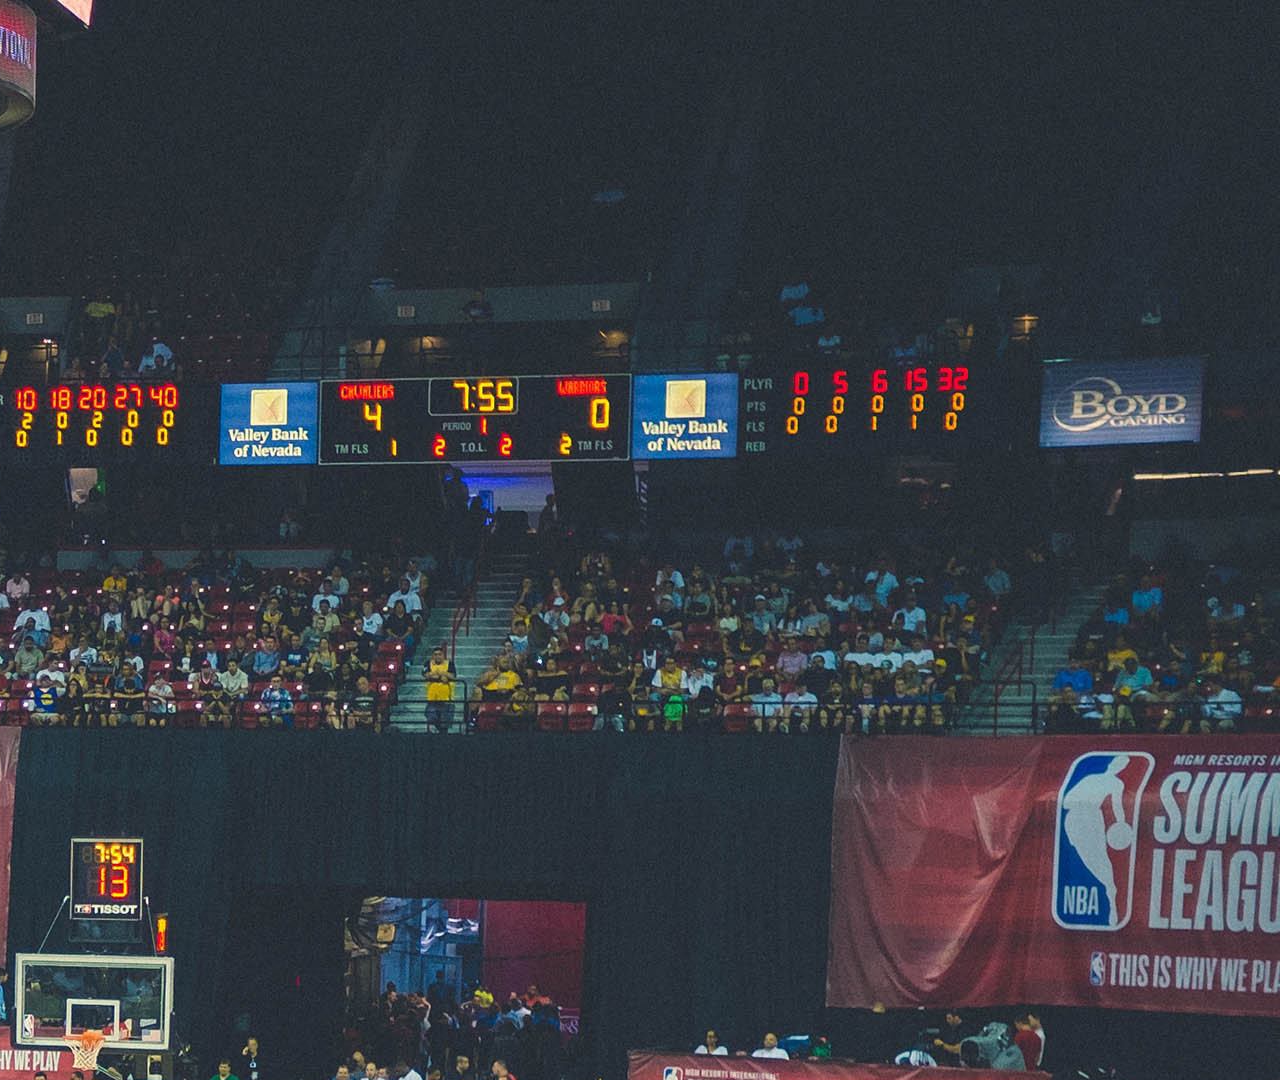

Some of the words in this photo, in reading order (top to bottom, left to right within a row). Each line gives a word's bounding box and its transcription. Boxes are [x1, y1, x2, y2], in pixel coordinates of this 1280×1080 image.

[744, 378, 773, 390] PLYR
[794, 372, 809, 396] 0
[834, 371, 848, 395] 5
[872, 370, 887, 394] 6
[906, 369, 928, 391] 15
[939, 367, 969, 391] 32
[16, 389, 37, 410] 10
[51, 388, 72, 409] 18
[80, 388, 106, 409] 20
[115, 386, 142, 408] 27
[149, 386, 177, 407] 40
[453, 379, 514, 412] 7:55
[747, 401, 766, 412] PTS
[793, 397, 805, 415] 0
[833, 396, 844, 415] 0
[872, 395, 884, 413] 0
[912, 394, 924, 412] 0
[952, 393, 964, 411] 0
[1071, 391, 1187, 419] BOYD
[22, 412, 33, 429] 2
[57, 411, 68, 429] 0
[92, 411, 103, 429] 2
[127, 410, 139, 428] 0
[163, 410, 175, 427] 0
[364, 402, 381, 431] 4
[590, 398, 609, 430] 0
[746, 421, 765, 433] FLS
[786, 416, 798, 434] 0
[826, 415, 838, 433] 0
[945, 413, 957, 431] 0
[1109, 413, 1186, 427] GAMING
[443, 421, 471, 431] PERIOD
[481, 417, 488, 434] 1
[642, 421, 685, 436] Valley
[688, 420, 728, 434] Bank
[16, 430, 28, 447] 0
[86, 429, 97, 446] 0
[121, 429, 133, 446] 0
[157, 428, 168, 445] 0
[228, 428, 268, 444] Valley
[271, 428, 308, 442] Bank
[560, 436, 572, 453] 2
[578, 440, 592, 450] TM
[596, 440, 613, 450] FLS
[647, 436, 665, 451] of
[667, 436, 721, 451] Nevada
[234, 443, 249, 458] of
[251, 443, 302, 458] Nevada
[334, 443, 350, 454] TM
[353, 443, 368, 454] FLS
[434, 438, 445, 456] 2
[500, 438, 512, 455] 2
[745, 441, 765, 452] REB
[1174, 754, 1204, 766] MGM
[1207, 754, 1267, 766] RESORTS
[94, 842, 136, 864] 7:54
[99, 865, 128, 898] 13
[91, 904, 138, 914] TISSOT
[1063, 885, 1100, 916] NBA
[1110, 952, 1150, 987] THIS
[1153, 954, 1172, 988] IS
[1175, 956, 1217, 990] WHY
[1221, 958, 1248, 992] WE
[15, 1049, 33, 1070] WE
[34, 1050, 61, 1072] PLAY
